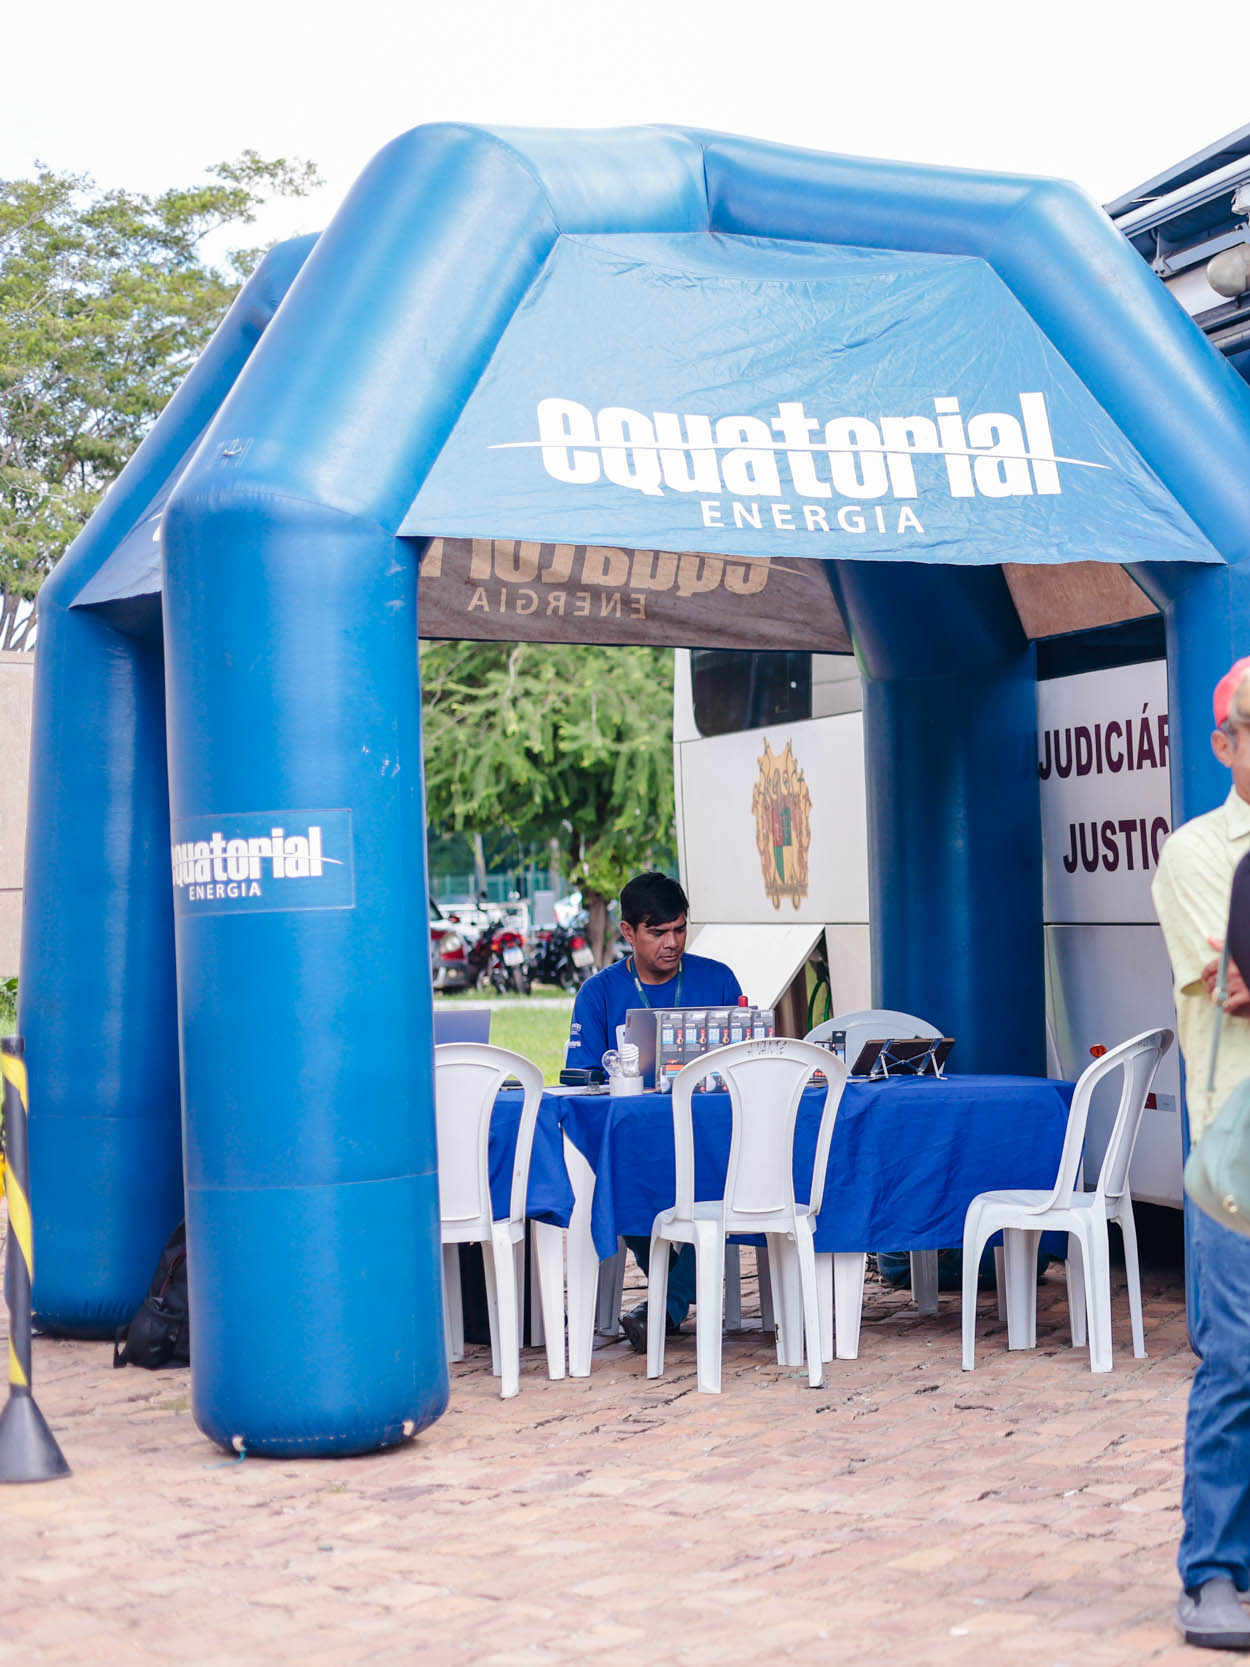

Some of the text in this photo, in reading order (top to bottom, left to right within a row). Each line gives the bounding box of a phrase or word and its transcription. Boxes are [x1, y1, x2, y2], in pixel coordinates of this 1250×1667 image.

[537, 391, 1063, 500] equatorial
[701, 501, 926, 535] ENERGIA
[188, 882, 262, 901] ENERGIA
